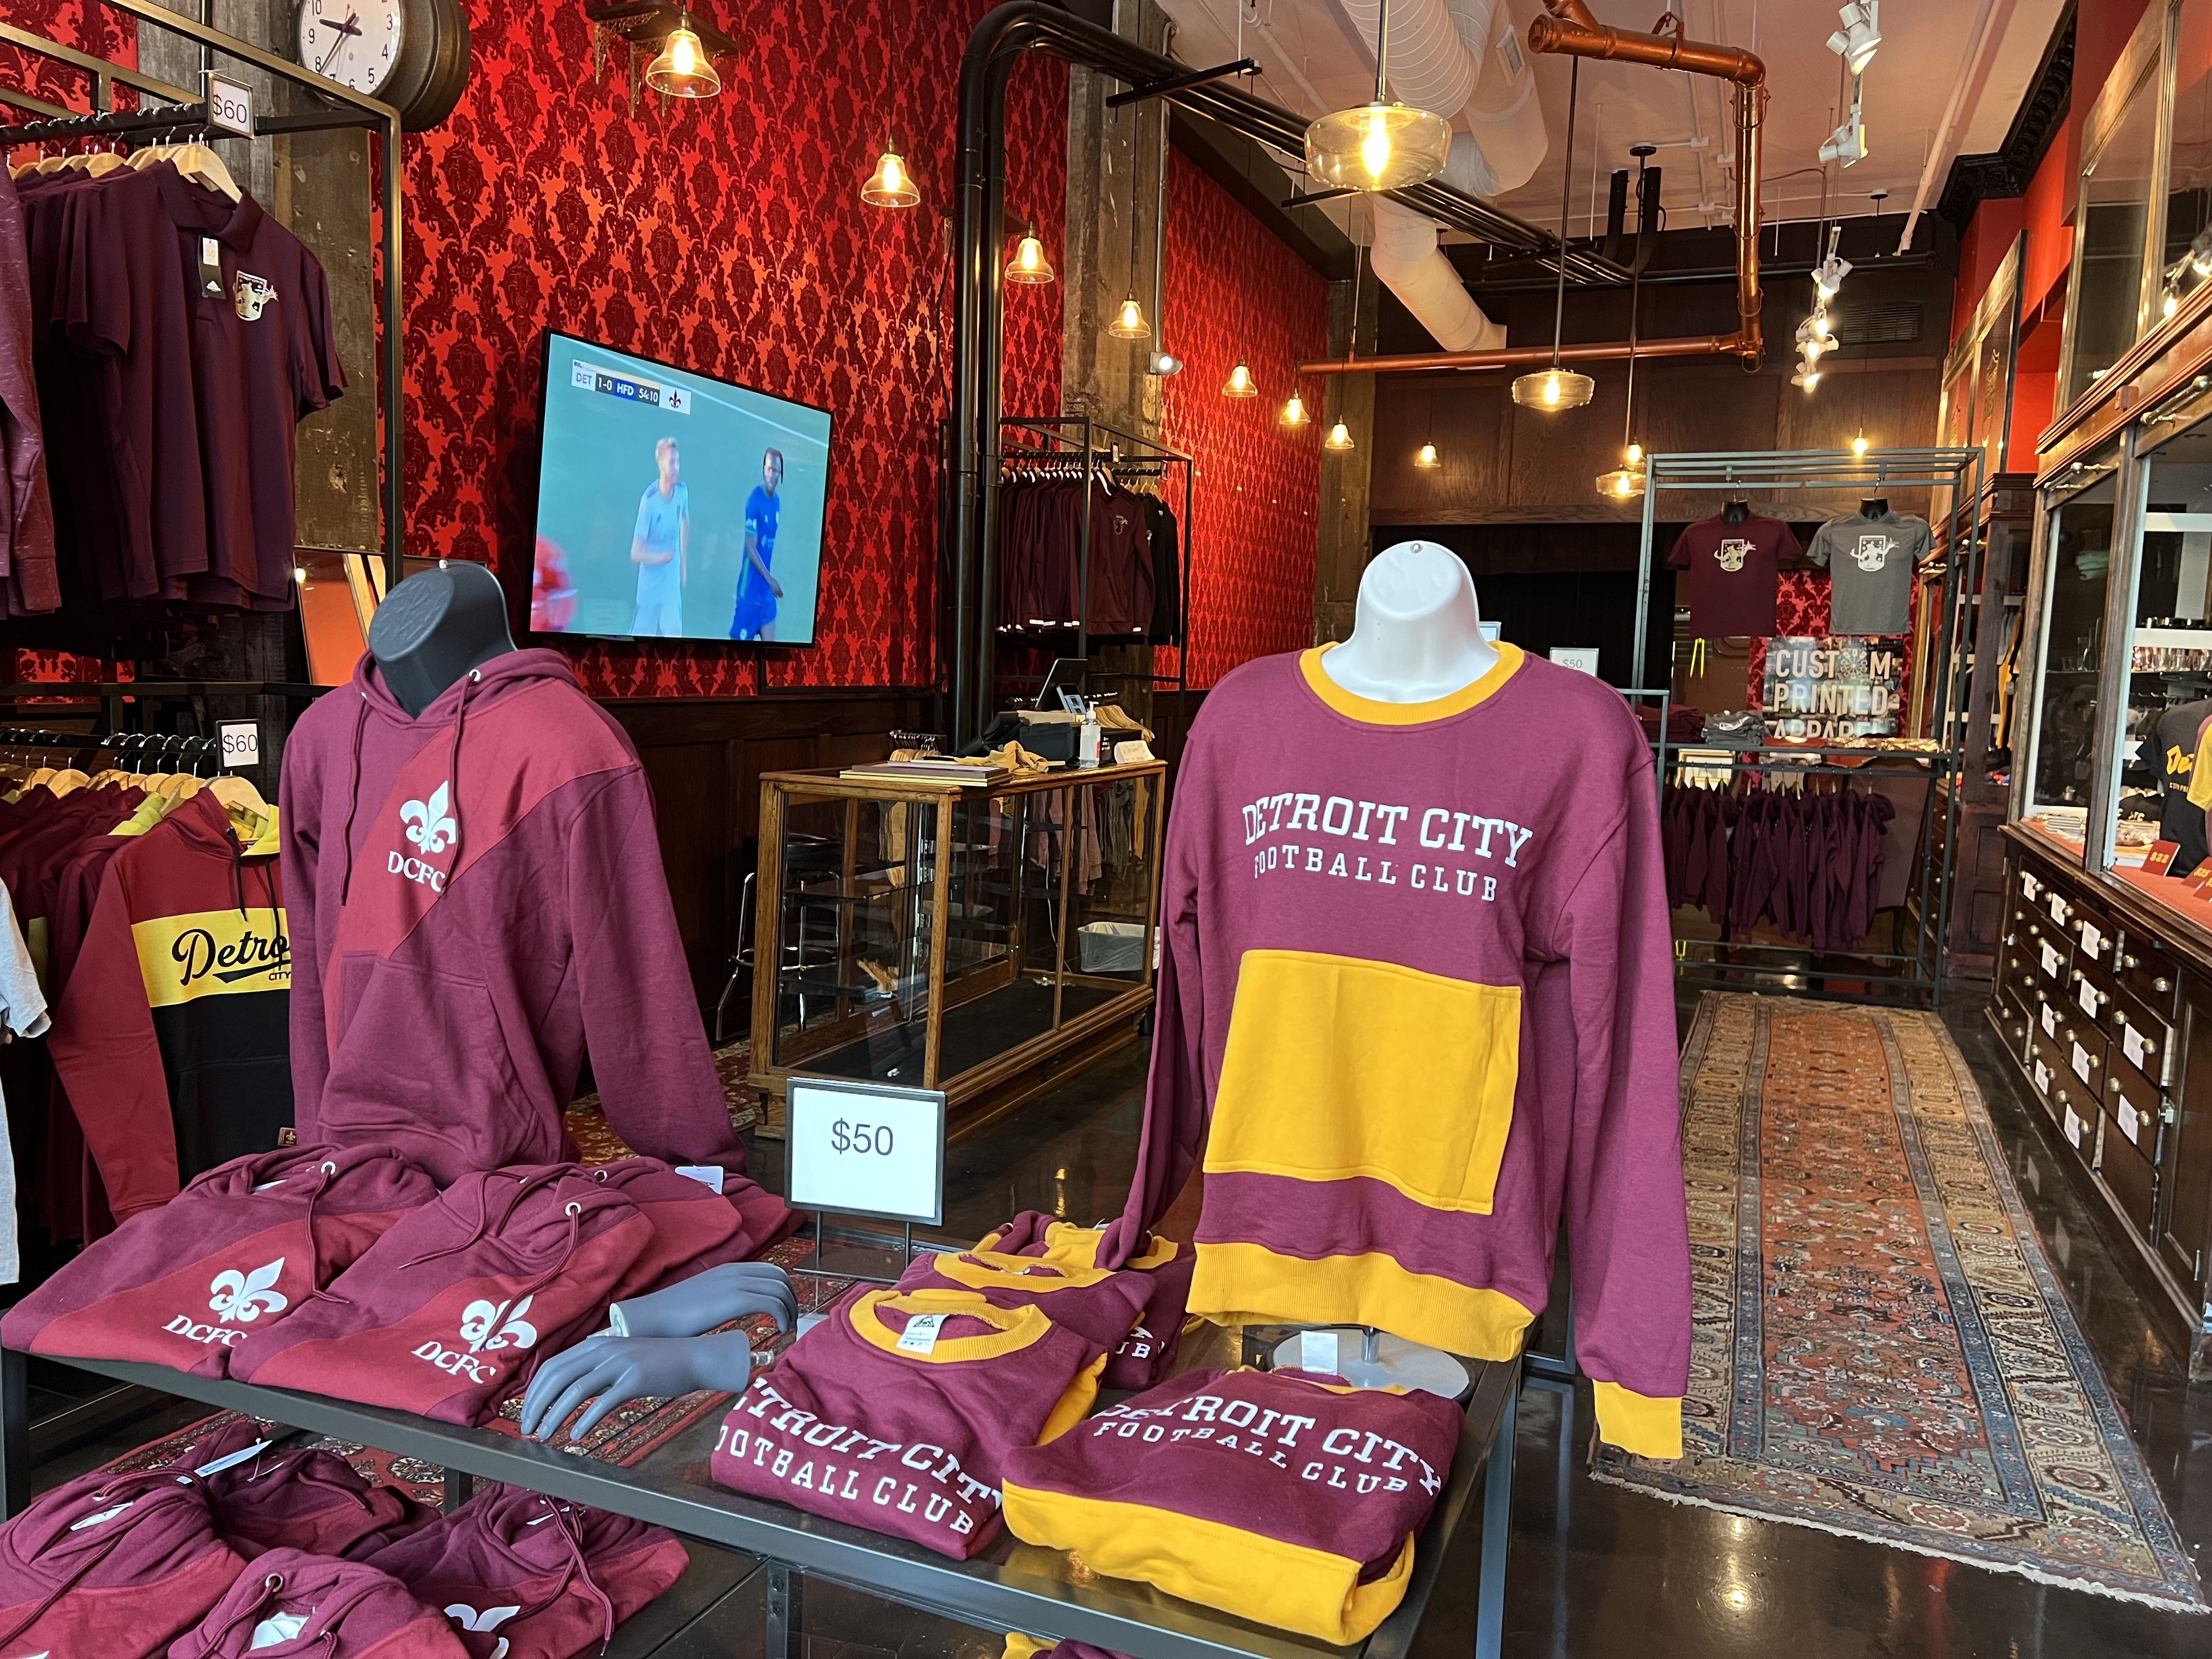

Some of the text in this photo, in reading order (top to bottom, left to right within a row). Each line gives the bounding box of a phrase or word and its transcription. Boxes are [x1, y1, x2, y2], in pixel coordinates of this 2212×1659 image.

[312, 0, 321, 16] 10
[386, 14, 393, 30] 3
[308, 28, 315, 44] 9
[315, 56, 321, 73] 8
[381, 44, 388, 60] 4
[368, 67, 375, 83] 5
[213, 93, 247, 123] $60
[576, 372, 592, 385] DET
[599, 377, 613, 391] 1-0
[617, 382, 634, 396] HFD
[1562, 659, 1582, 668] $50
[1774, 683, 1888, 715] PRINTED
[223, 733, 258, 755] $60
[1242, 793, 1533, 868] DETROIT CITY
[2150, 851, 2170, 864] $22
[388, 851, 445, 892] DCFC
[1255, 844, 1497, 901] FOOTBALL CLUB
[268, 972, 291, 981] CITY
[831, 1118, 893, 1156] $50
[161, 1314, 247, 1347] DCFC
[411, 1341, 496, 1384] DCFC
[1091, 1396, 1441, 1496] DETROIT CITY
[1093, 1422, 1408, 1493] FOOTBALL CLUB
[872, 1476, 974, 1534] CLUB
